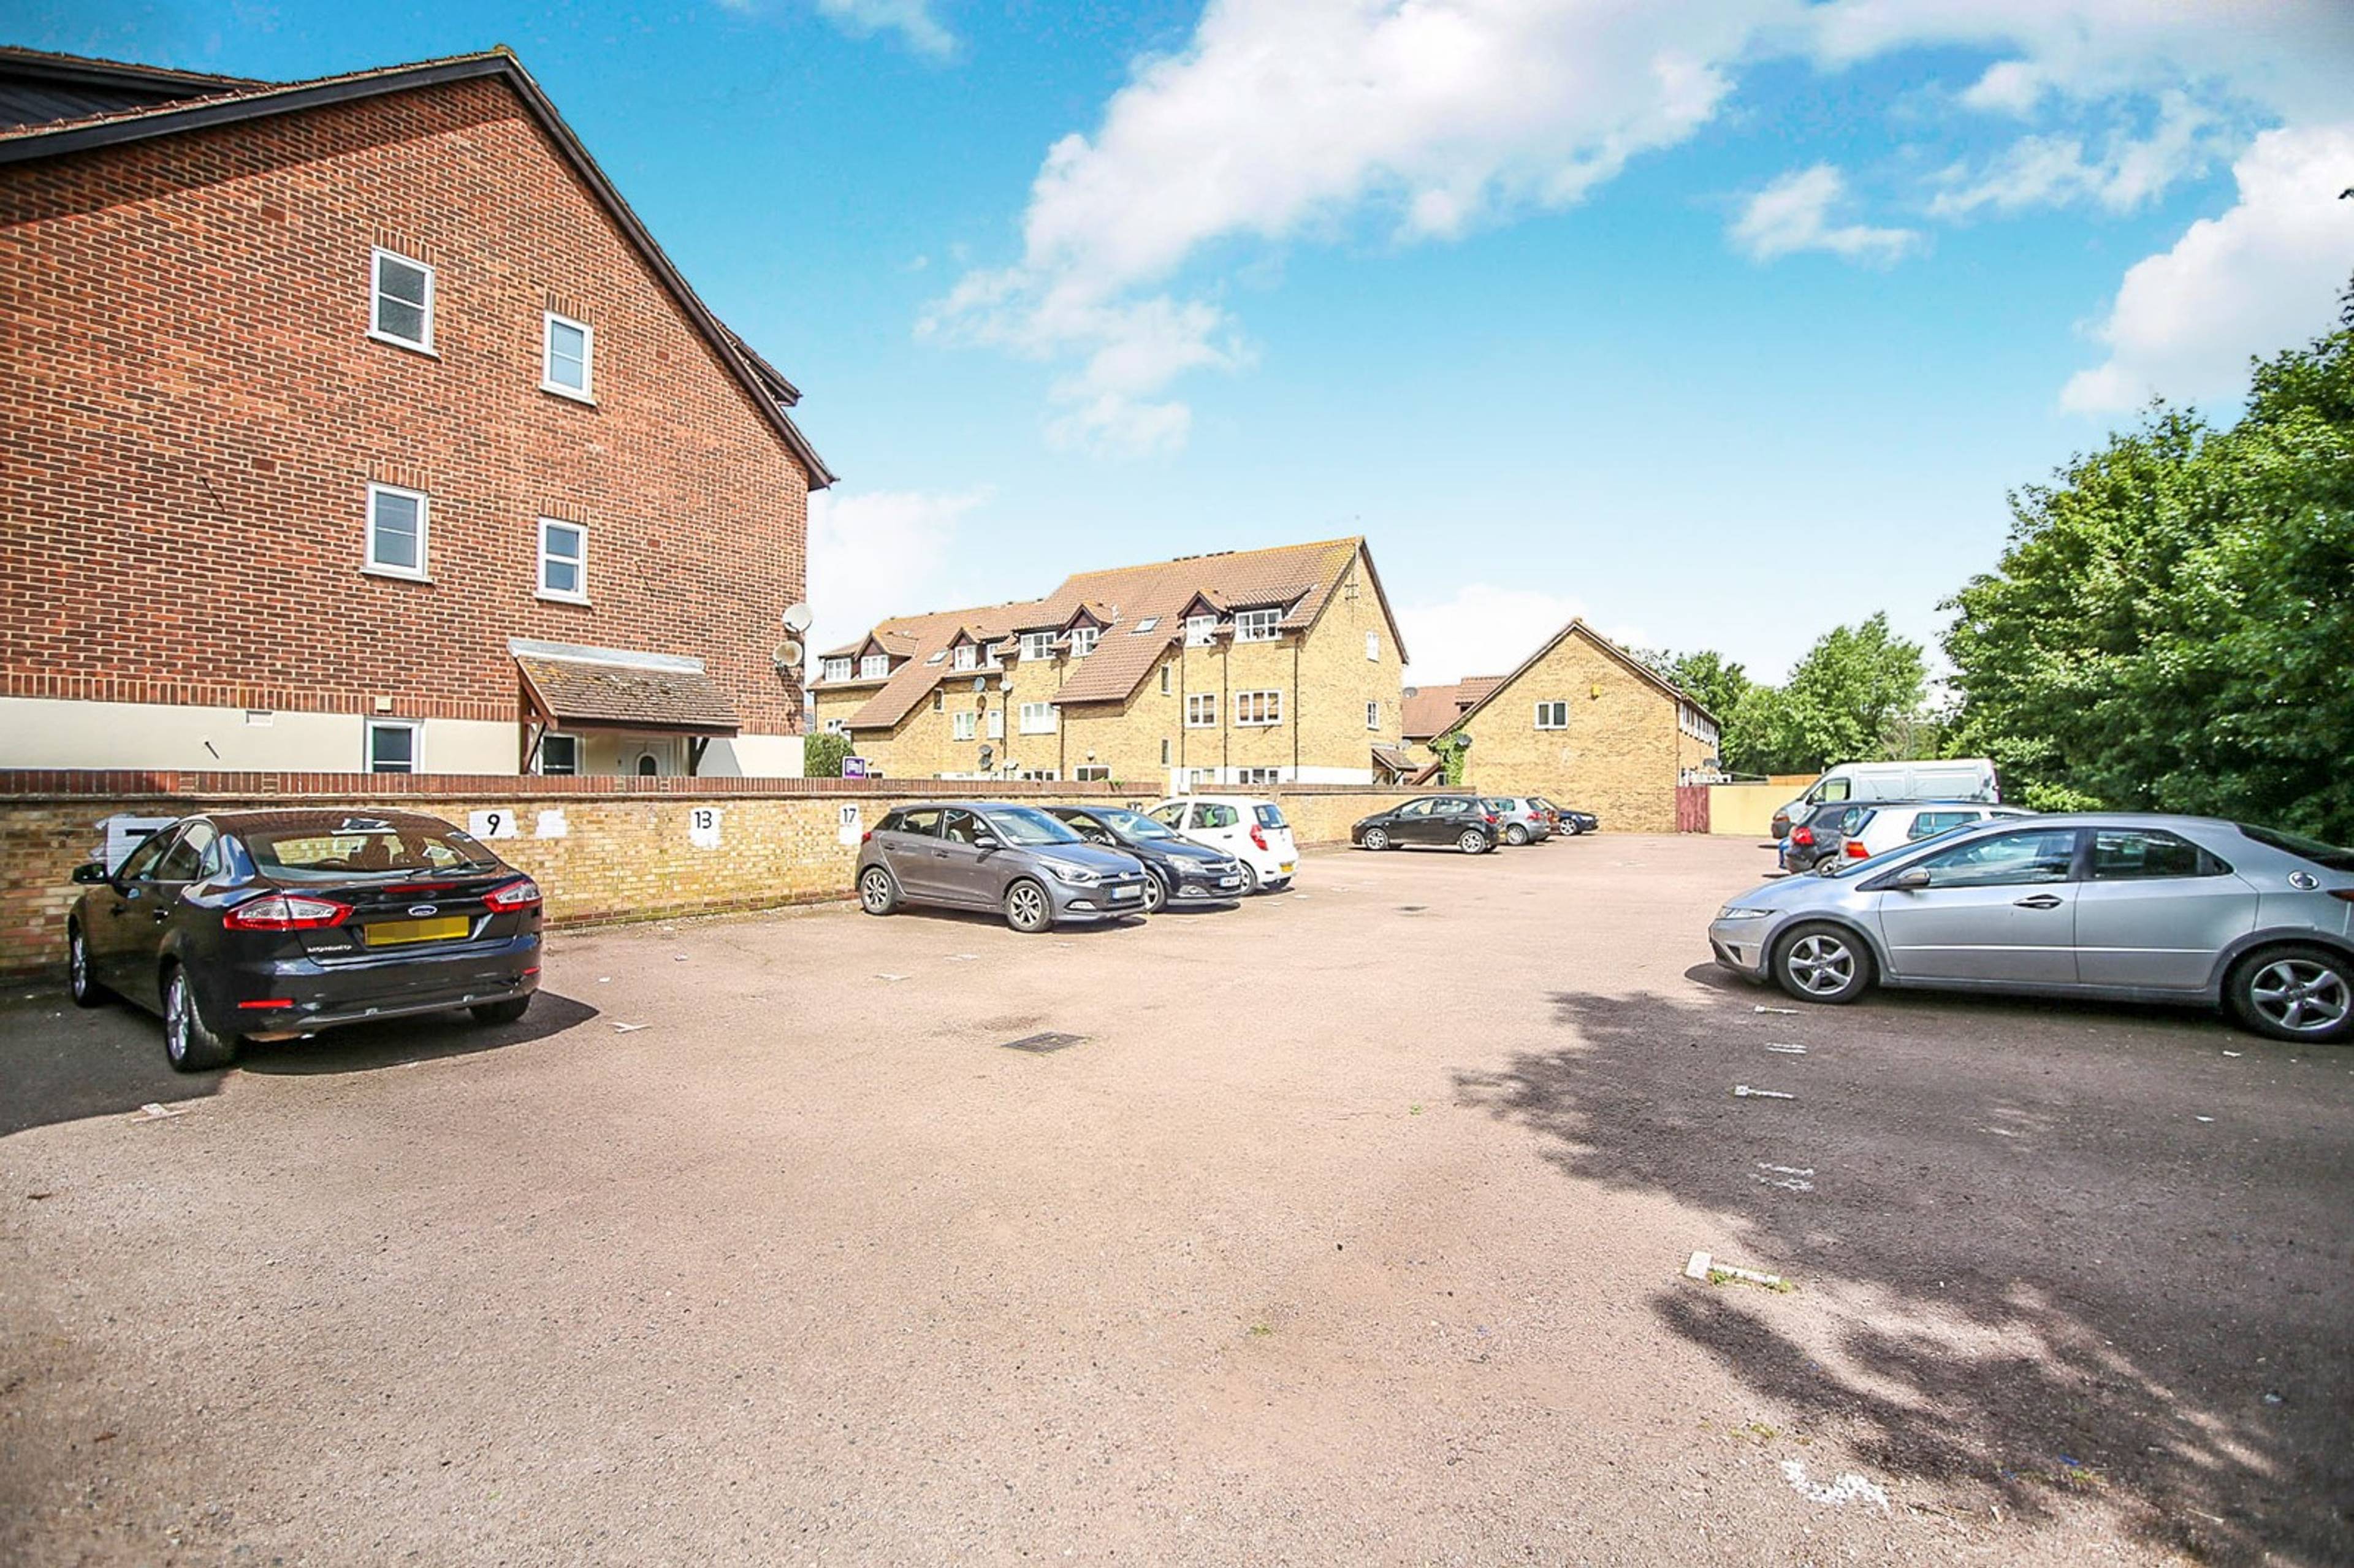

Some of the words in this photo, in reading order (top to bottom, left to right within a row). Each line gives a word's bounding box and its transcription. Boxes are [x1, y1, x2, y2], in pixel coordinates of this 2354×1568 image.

[487, 813, 500, 835] 9
[694, 810, 712, 829] 13
[843, 807, 856, 823] 17
